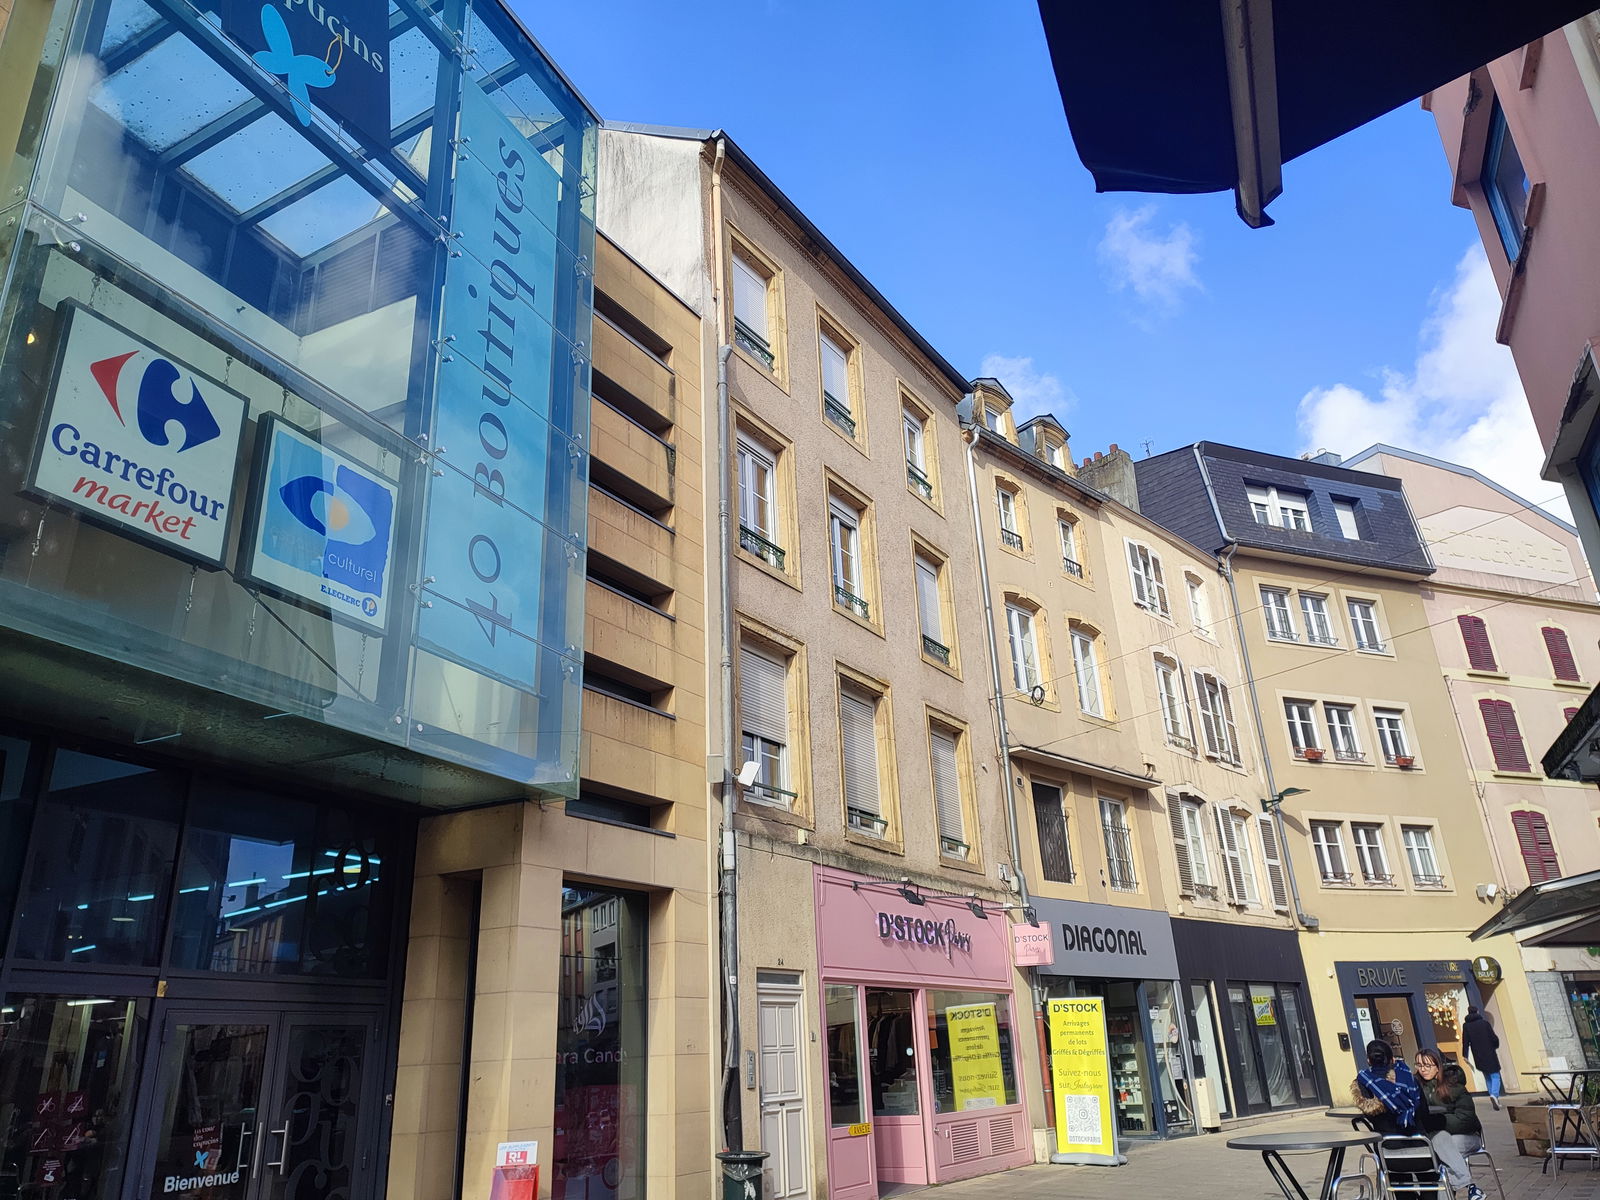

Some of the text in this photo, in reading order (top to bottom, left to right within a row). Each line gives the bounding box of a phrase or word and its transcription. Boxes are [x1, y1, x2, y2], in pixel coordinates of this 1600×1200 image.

[468, 137, 536, 509] Boutiques
[52, 423, 225, 521] Carrefour
[72, 476, 198, 540] market
[328, 553, 377, 582] culturel
[320, 584, 361, 607] E.LECLERC
[878, 912, 945, 946] D'STOCK
[1061, 923, 1147, 956] DIAGONAL
[1357, 967, 1408, 987] BRUNE
[1053, 1003, 1099, 1013] D'STOCK
[1062, 1020, 1090, 1028] Arrivages
[1058, 1068, 1102, 1077] Suivez-nous
[163, 1171, 240, 1193] Bienvenue
